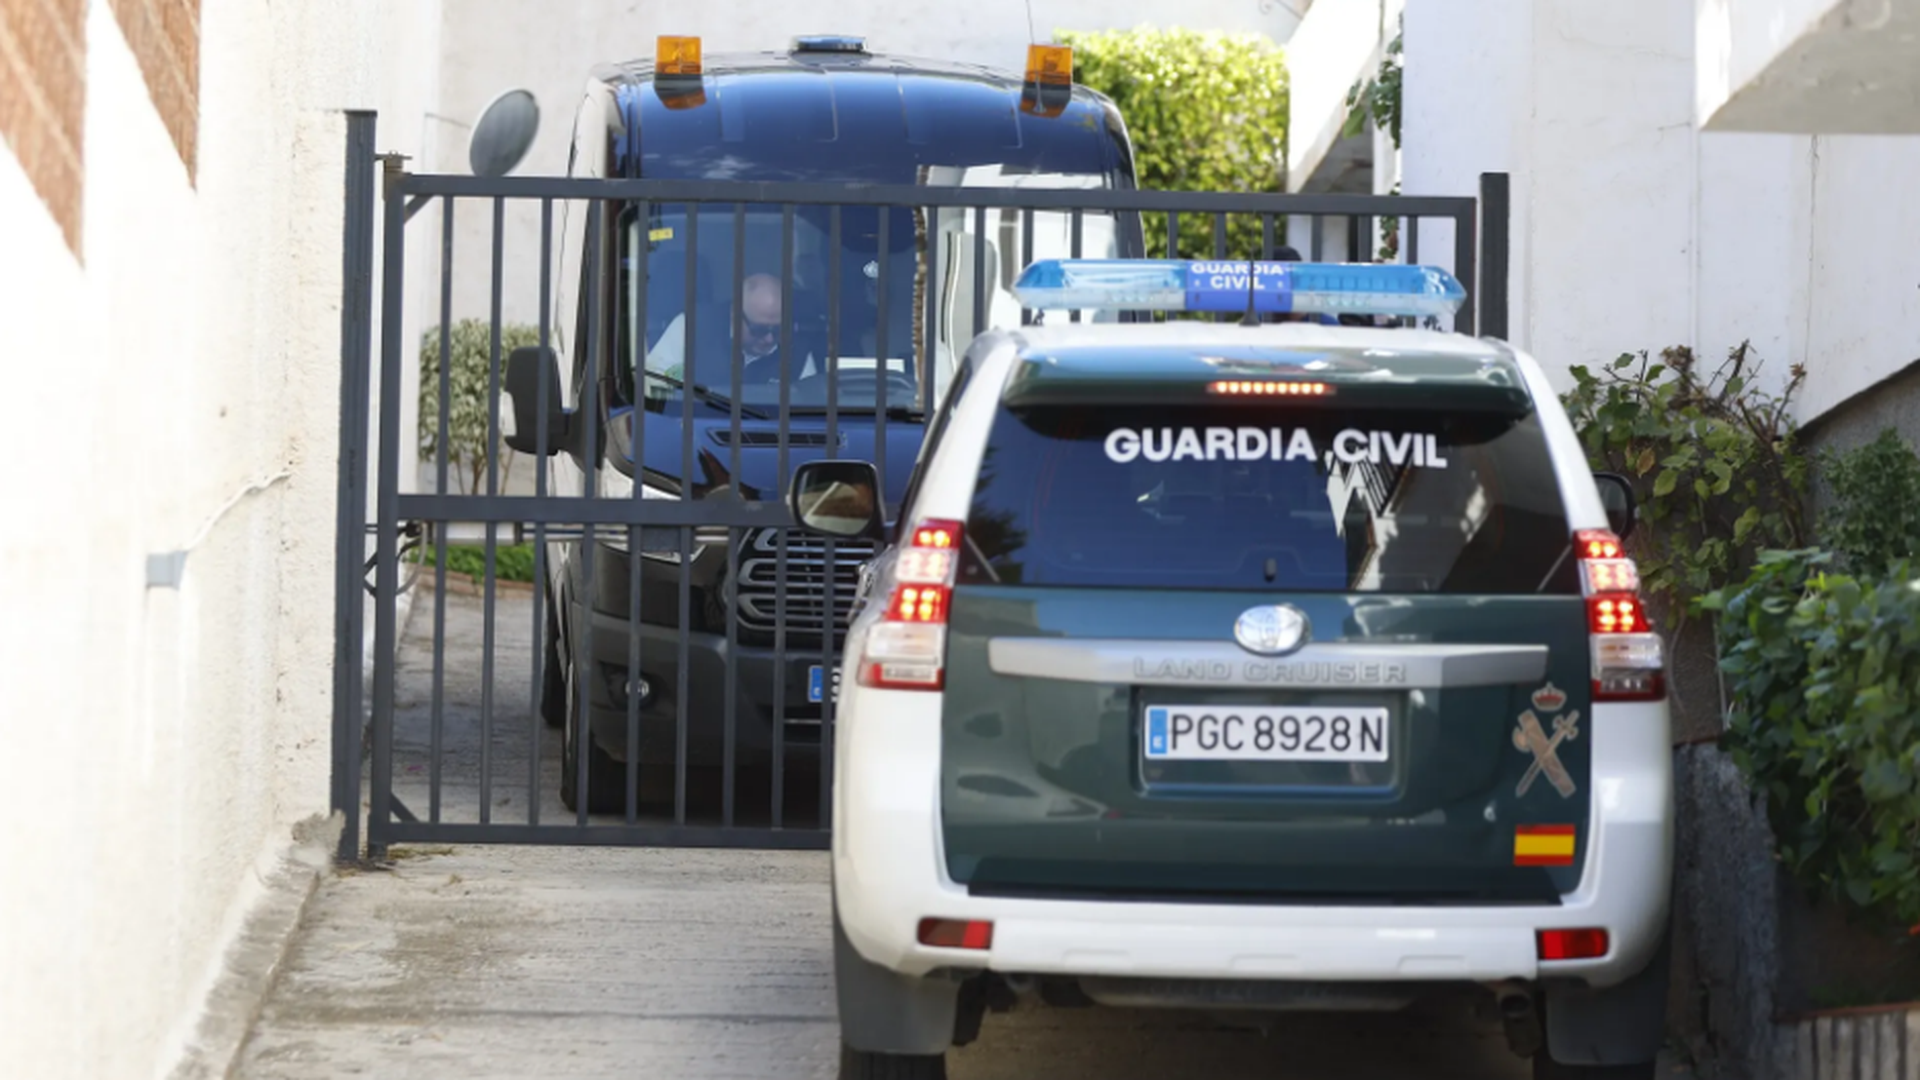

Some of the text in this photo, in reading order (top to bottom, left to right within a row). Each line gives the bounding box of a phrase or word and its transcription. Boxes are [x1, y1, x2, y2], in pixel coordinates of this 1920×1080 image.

[1191, 262, 1284, 275] GUARDIA
[1210, 275, 1265, 289] CIVIL
[1104, 427, 1447, 468] GUARDIA CIVIL
[1132, 656, 1406, 683] LAND CRUISER
